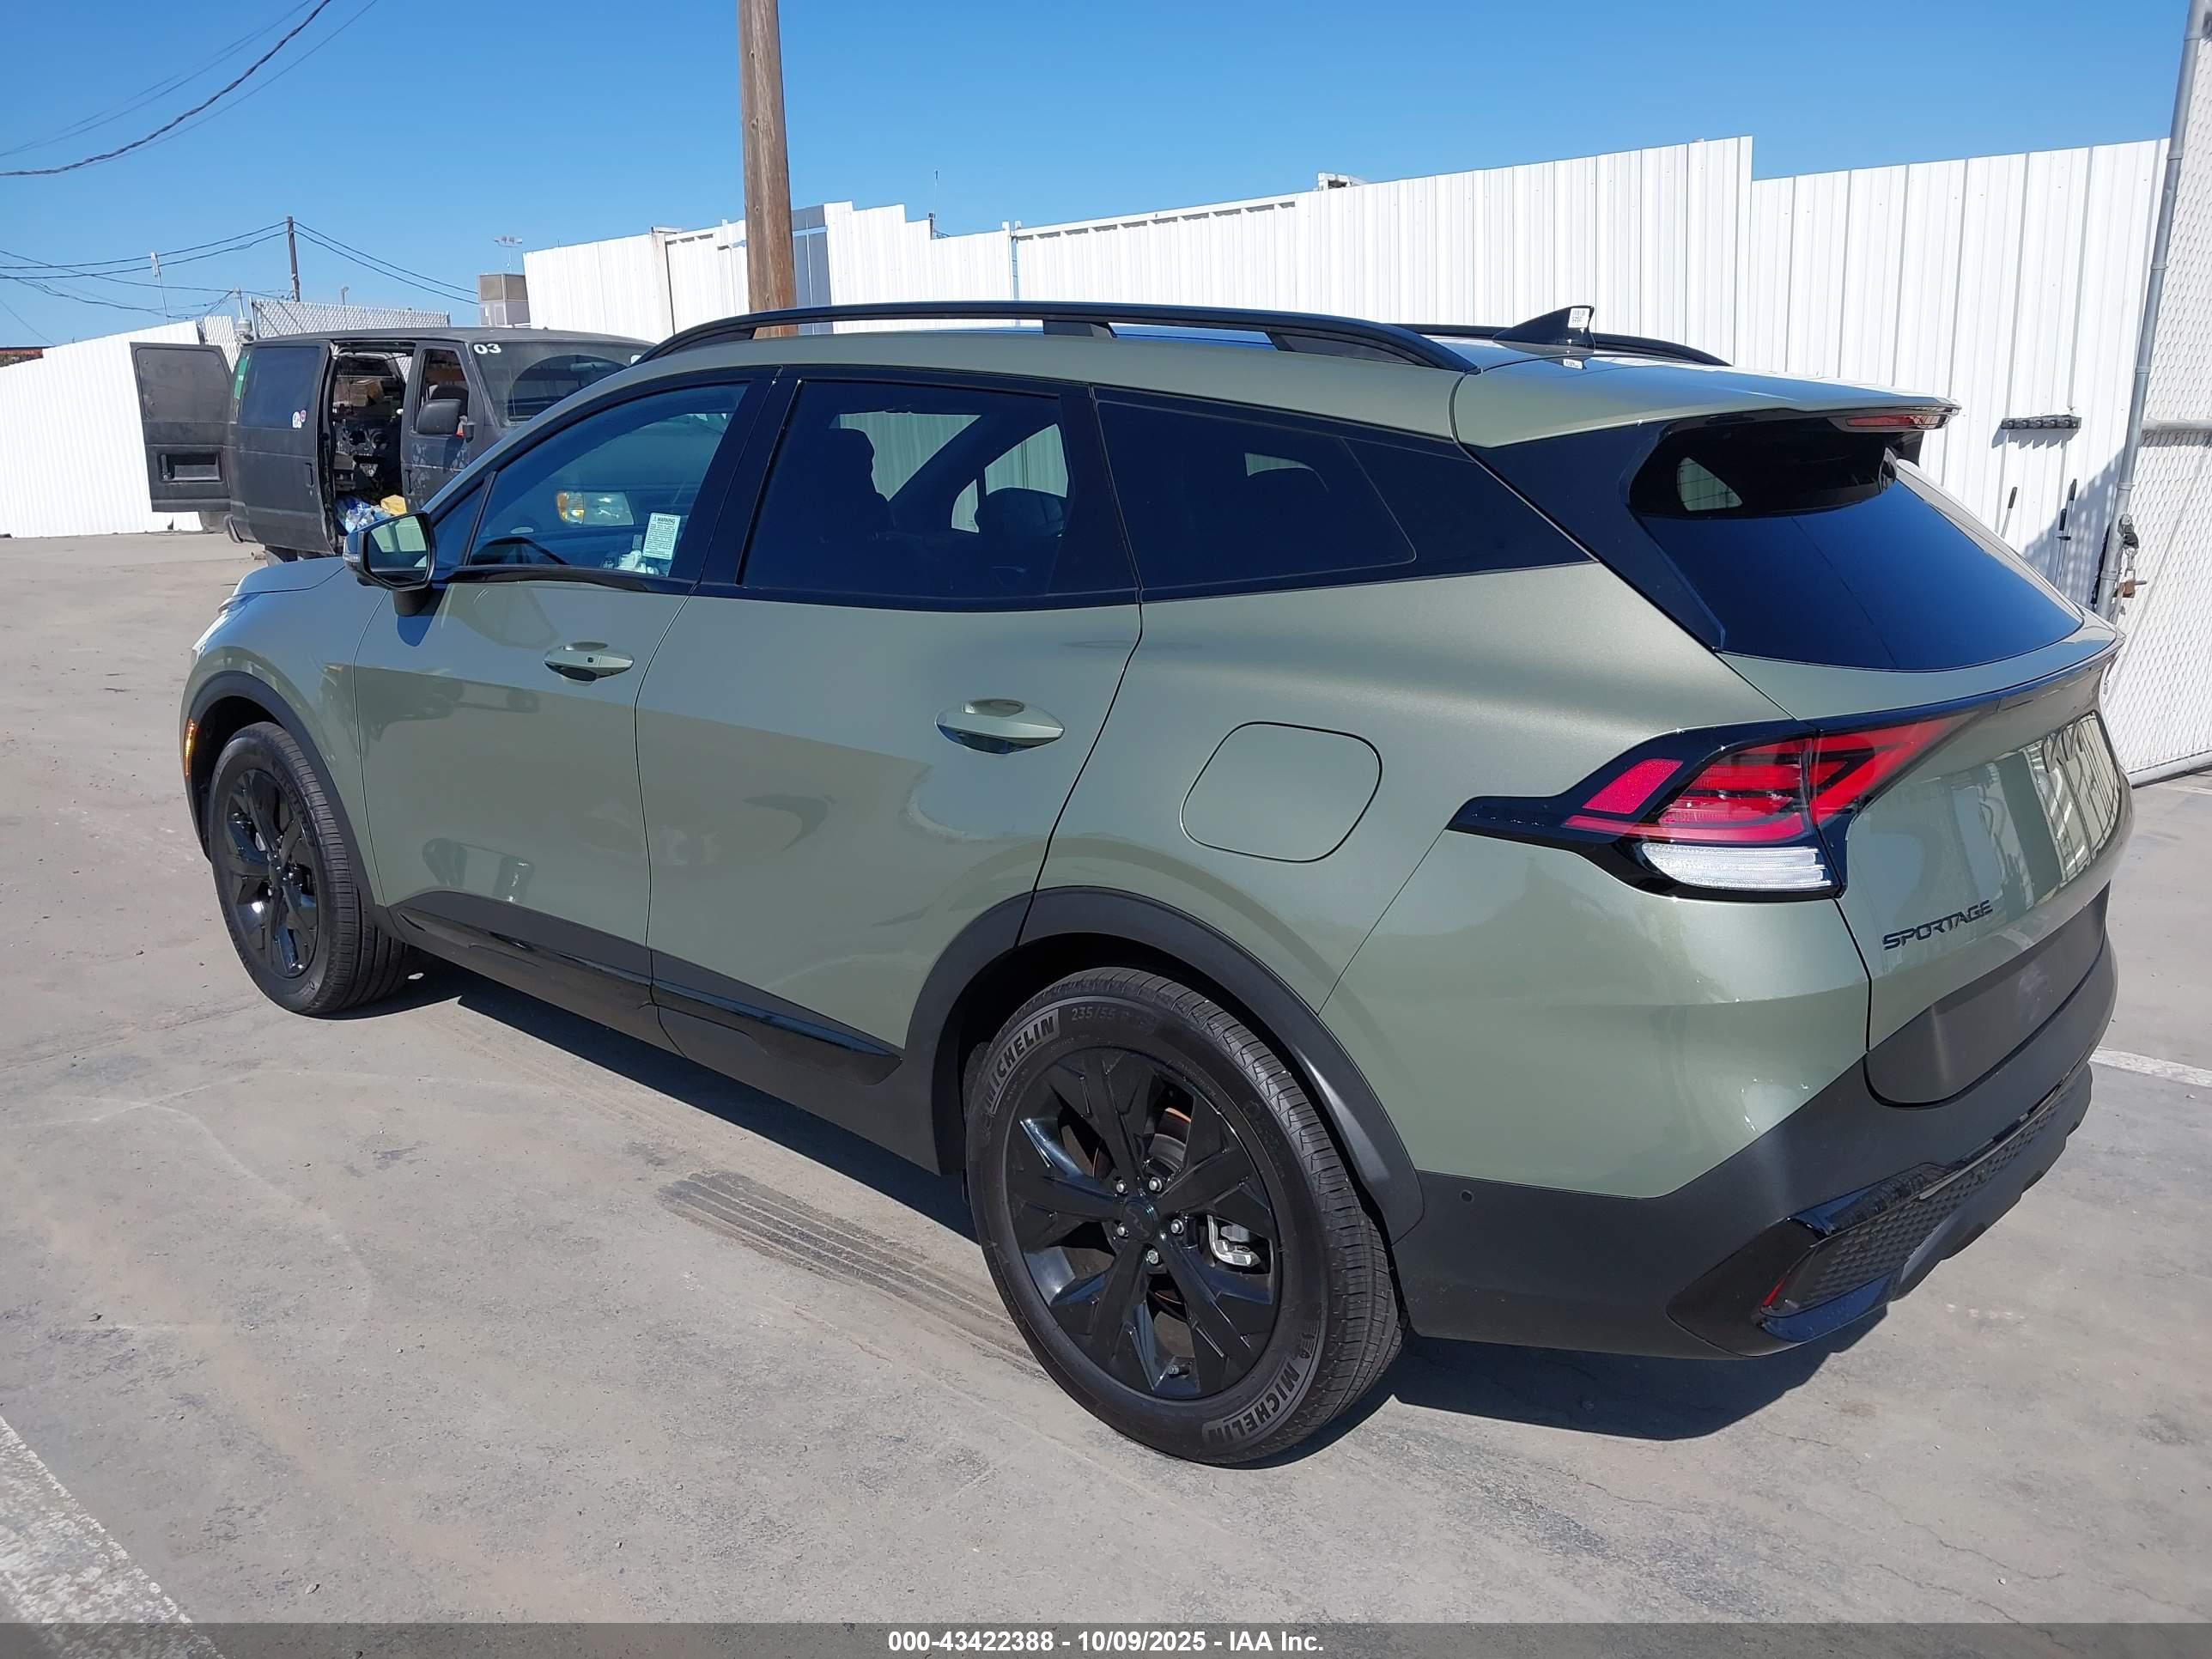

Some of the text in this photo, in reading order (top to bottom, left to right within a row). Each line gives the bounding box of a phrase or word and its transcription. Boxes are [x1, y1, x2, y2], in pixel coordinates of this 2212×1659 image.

[473, 343, 502, 355] 03
[1882, 899, 1993, 951] SPORTAGE
[985, 1015, 1055, 1109] MICHELIN
[1208, 1361, 1300, 1443] MICHELIN
